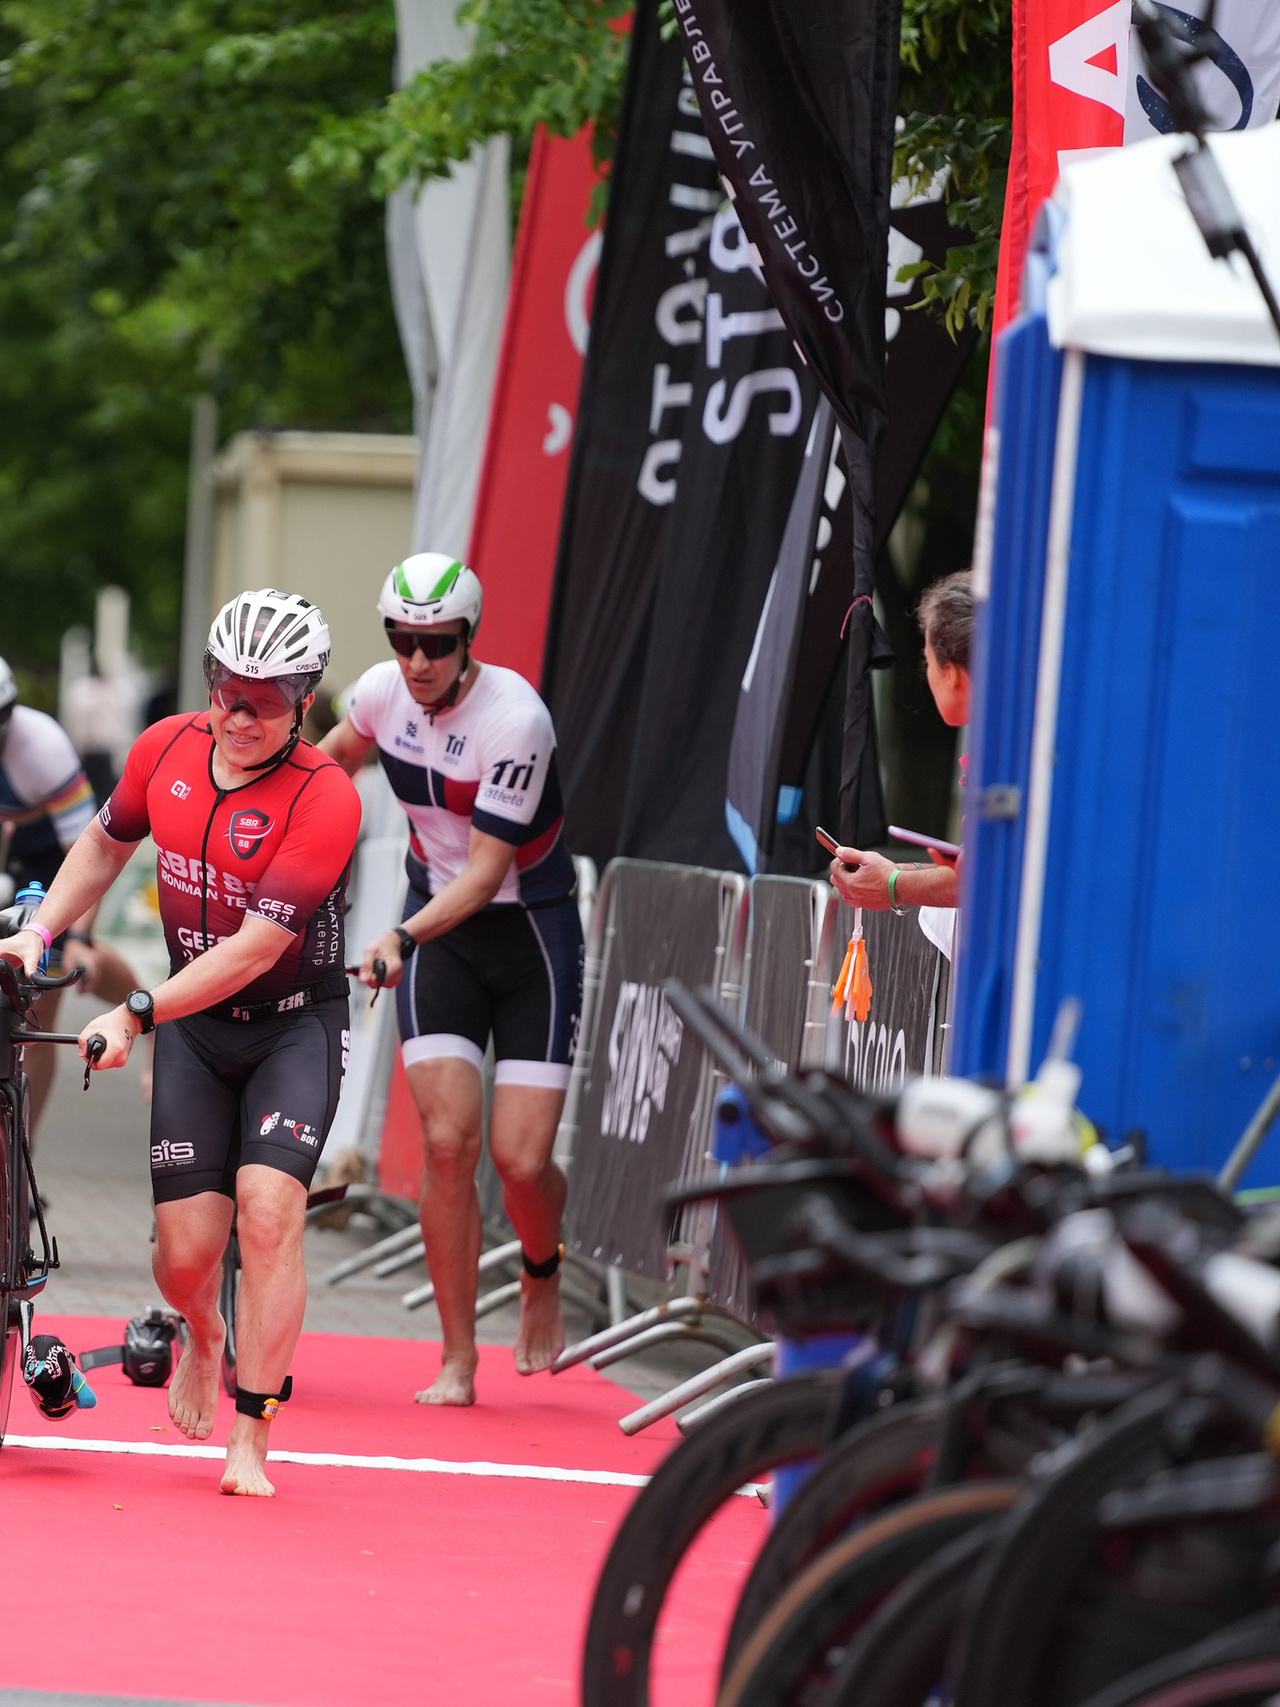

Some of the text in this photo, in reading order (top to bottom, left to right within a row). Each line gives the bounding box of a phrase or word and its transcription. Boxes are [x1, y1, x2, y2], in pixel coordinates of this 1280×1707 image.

[749, 163, 845, 323] СИСТЕМА
[244, 664, 259, 675] 515
[444, 733, 467, 756] Tri
[491, 753, 538, 791] Tri
[484, 786, 525, 807] atleta
[238, 817, 260, 828] SBR
[237, 838, 250, 849] 88
[154, 845, 218, 888] SBR
[257, 897, 297, 916] GES
[311, 920, 327, 966] центр
